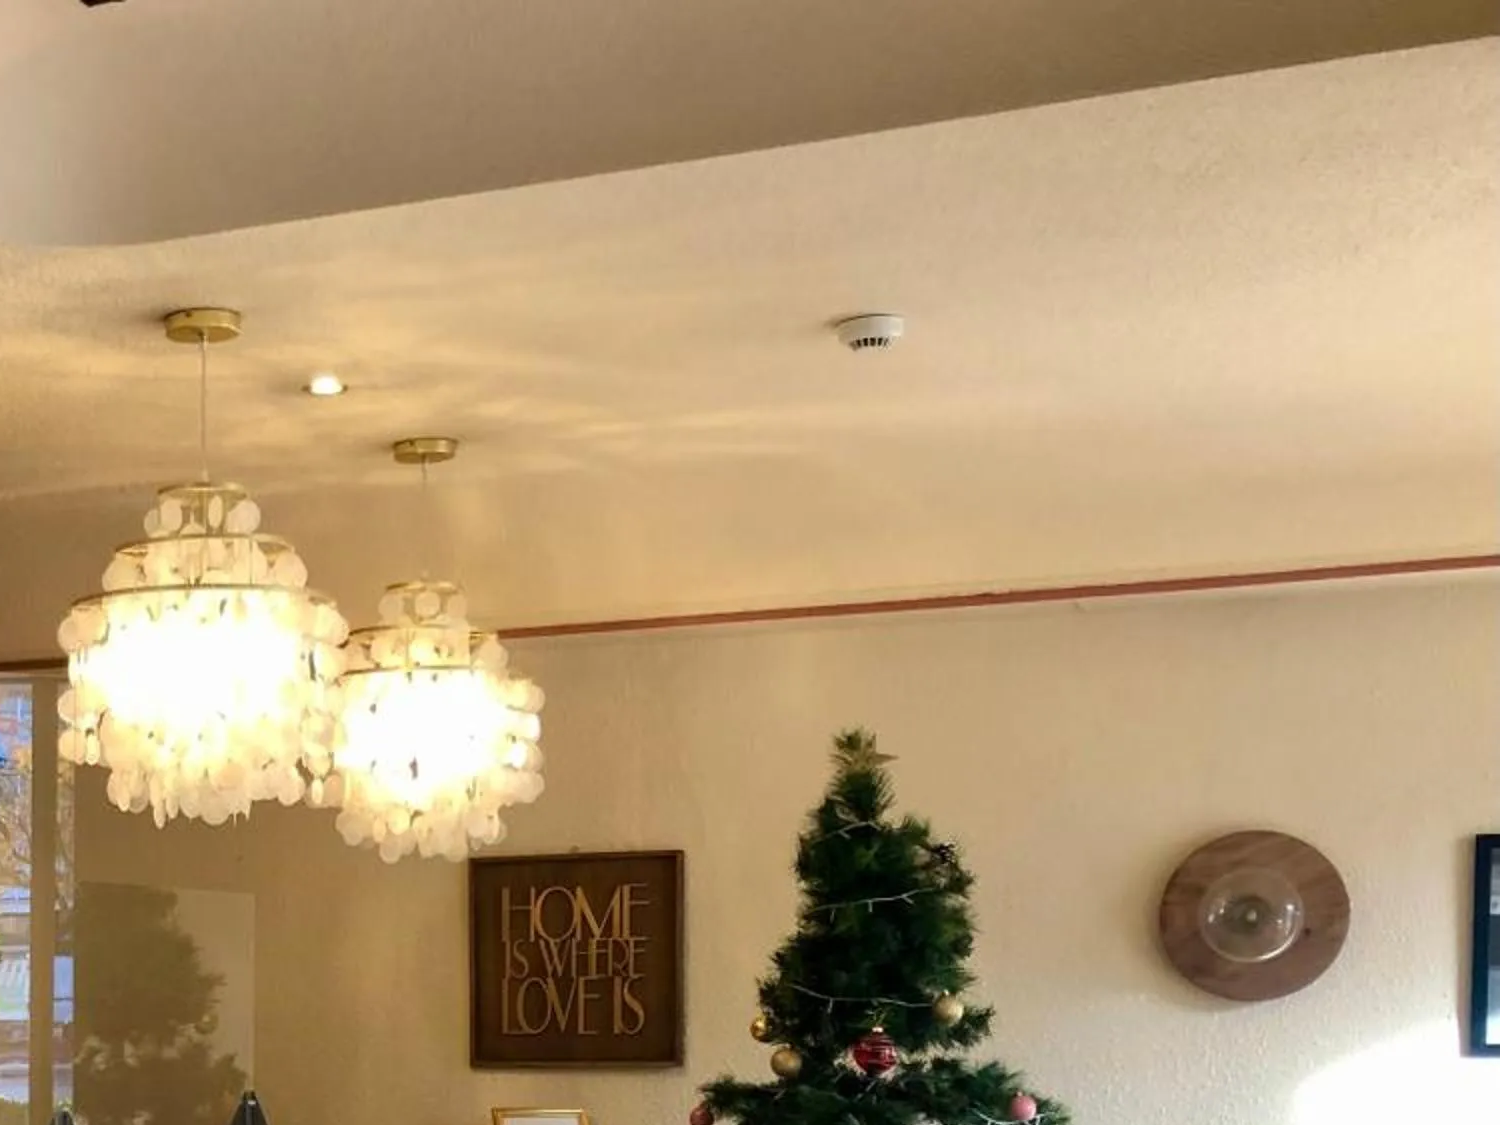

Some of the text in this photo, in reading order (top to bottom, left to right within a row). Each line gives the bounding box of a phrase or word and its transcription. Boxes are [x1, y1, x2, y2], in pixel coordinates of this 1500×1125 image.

[501, 883, 649, 942] HOME
[504, 937, 646, 979] IS WHERE
[502, 975, 645, 1035] LOVE IS
